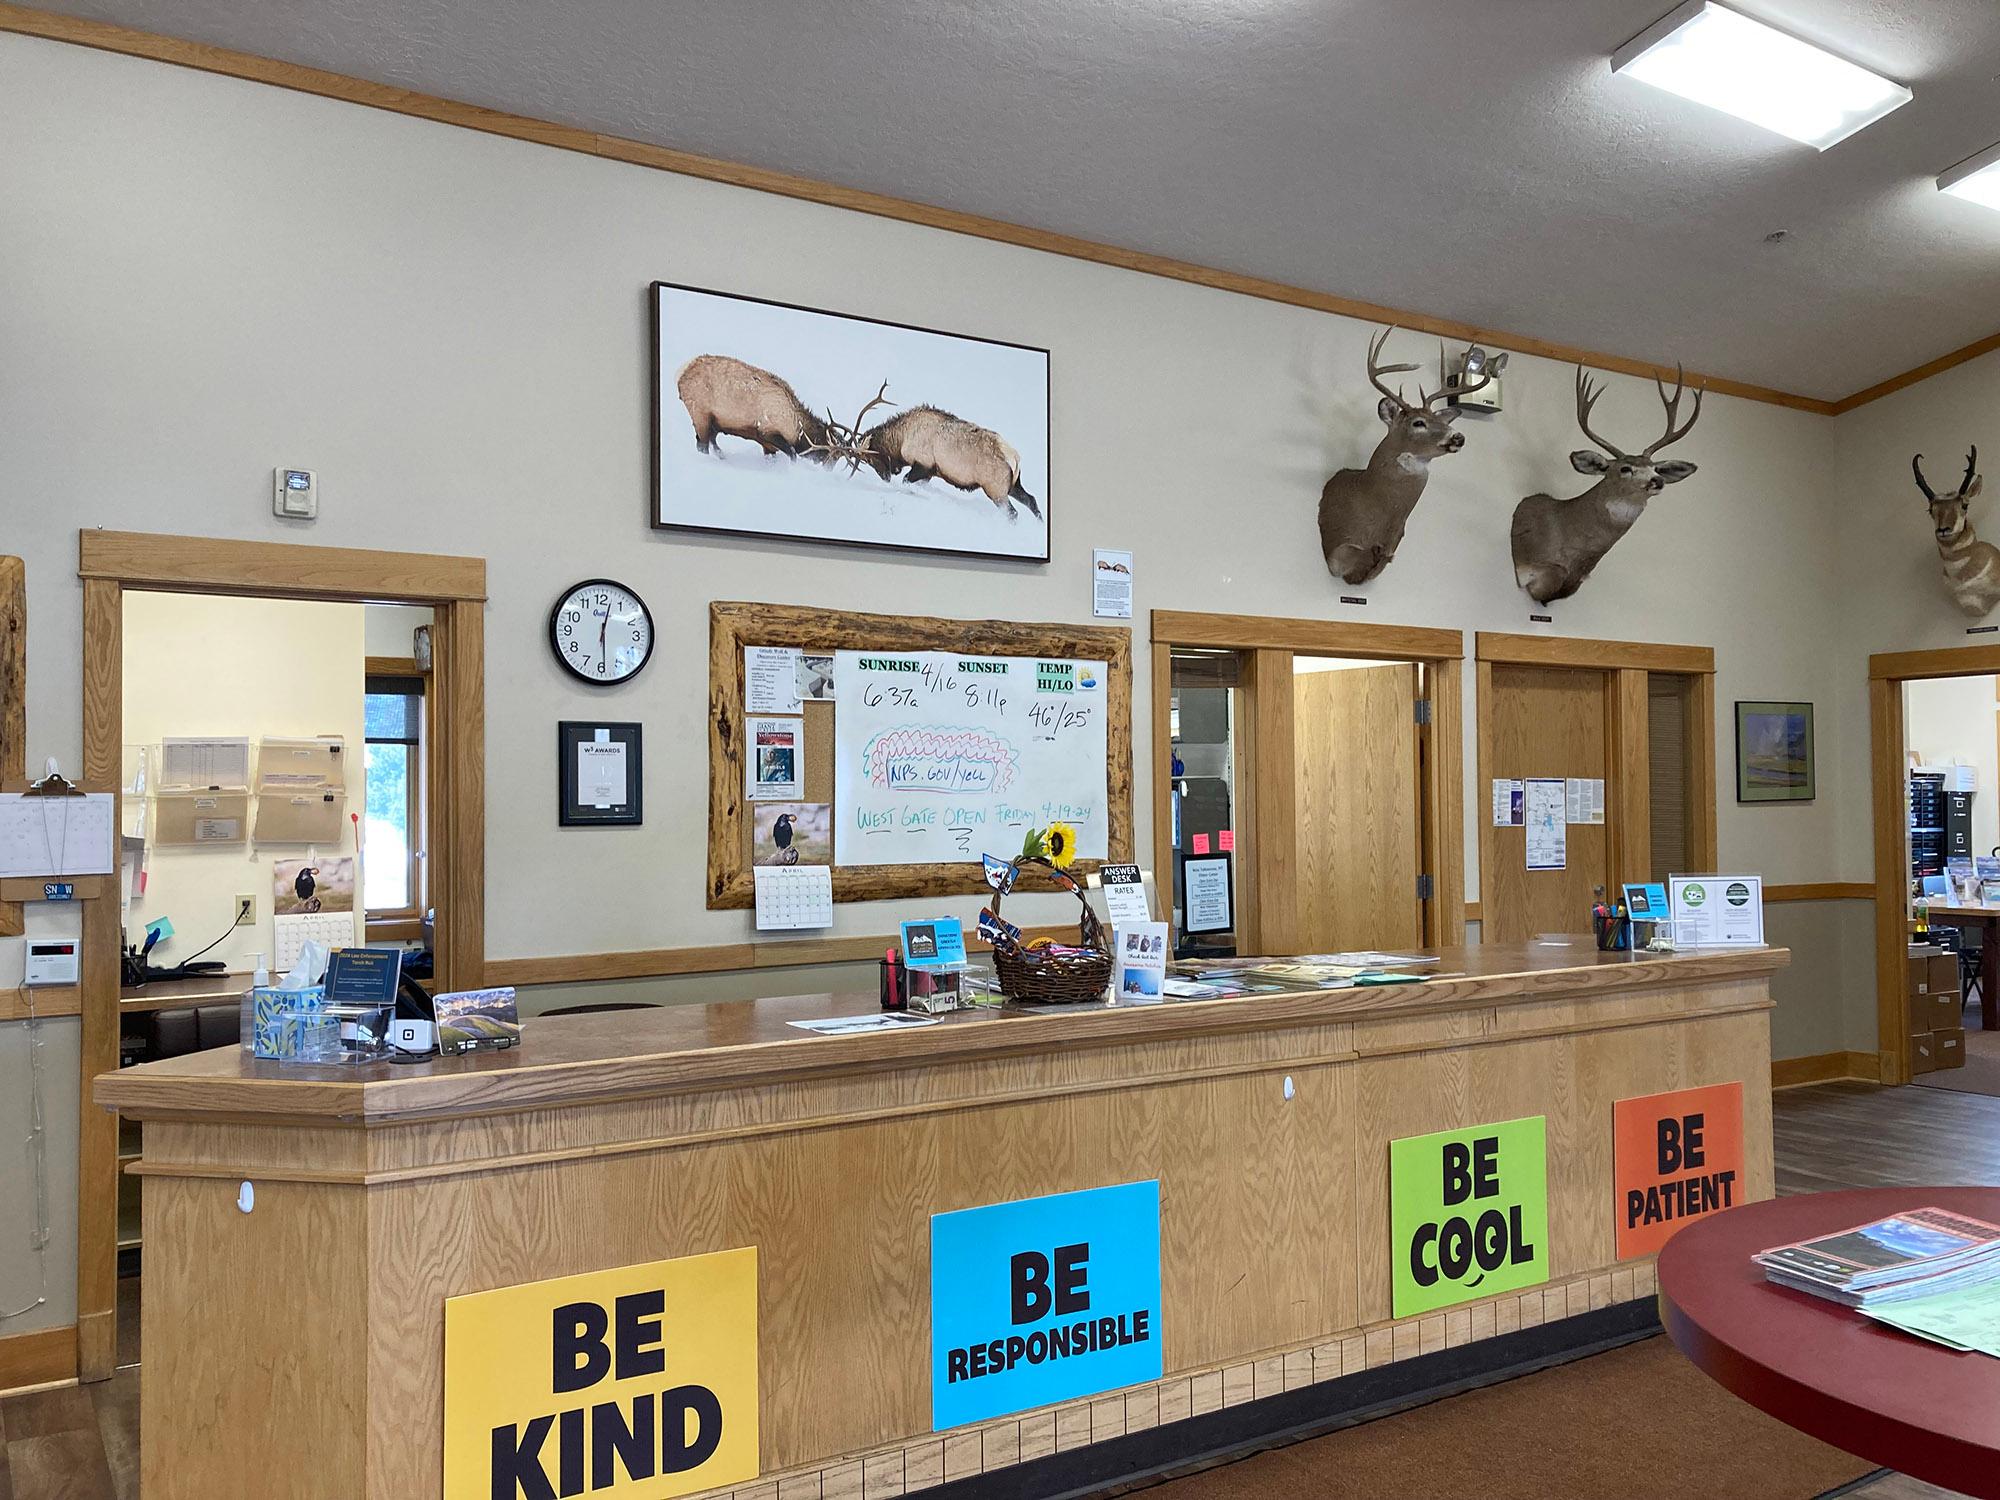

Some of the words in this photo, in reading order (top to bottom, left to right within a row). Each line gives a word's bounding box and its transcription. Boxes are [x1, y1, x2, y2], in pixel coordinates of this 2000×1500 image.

[580, 599, 590, 609] 11
[594, 595, 608, 606] 12
[617, 602, 623, 612] 1
[567, 612, 581, 623] 10
[564, 625, 572, 636] 9
[632, 630, 640, 642] 3
[570, 641, 579, 653] 8
[582, 655, 591, 666] 7
[859, 658, 920, 673] SUNRISE
[597, 662, 606, 674] 6
[958, 661, 1009, 674] SUNSET
[1038, 663, 1072, 674] TEMP
[921, 663, 957, 693] 4/16
[1037, 679, 1074, 692] HI/LO
[864, 683, 919, 707] 6:37a
[857, 806, 896, 829] WEST
[901, 805, 938, 826] GATE
[943, 808, 987, 826] OPEN
[1104, 867, 1137, 875] ANSWER
[45, 885, 73, 894] SNW
[1114, 886, 1134, 895] RATES
[1658, 1113, 1705, 1175] BE
[1443, 1137, 1500, 1206] BE
[1628, 1170, 1736, 1229] PATIENT
[1410, 1204, 1534, 1287] COOL
[1011, 1242, 1090, 1325] BE
[552, 1289, 666, 1394] BE
[948, 1310, 1150, 1384] RESPONSIBLE
[491, 1384, 723, 1500] KIND
